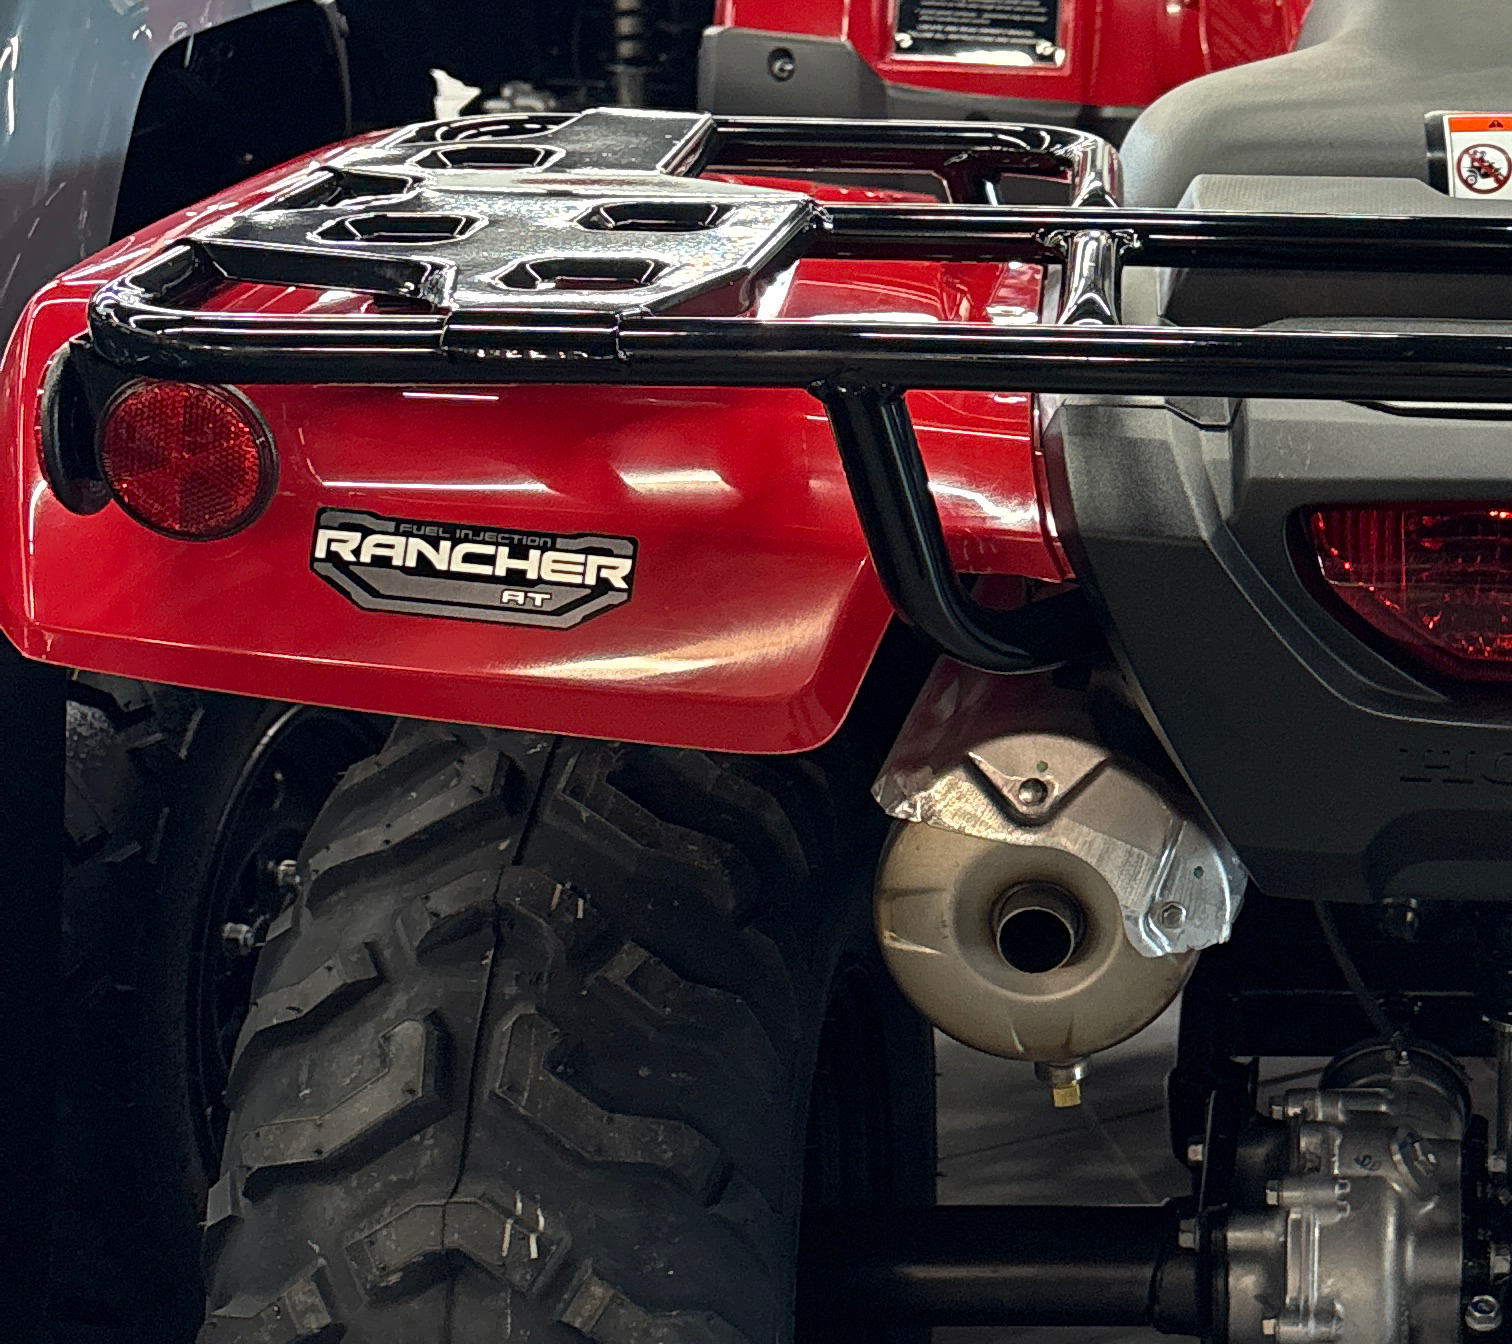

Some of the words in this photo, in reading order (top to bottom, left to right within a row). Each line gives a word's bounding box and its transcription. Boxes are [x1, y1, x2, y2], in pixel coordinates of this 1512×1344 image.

[400, 524, 453, 539] FUEL
[455, 529, 552, 547] INJECTION
[314, 528, 633, 589] RANCHER
[501, 589, 552, 607] AT
